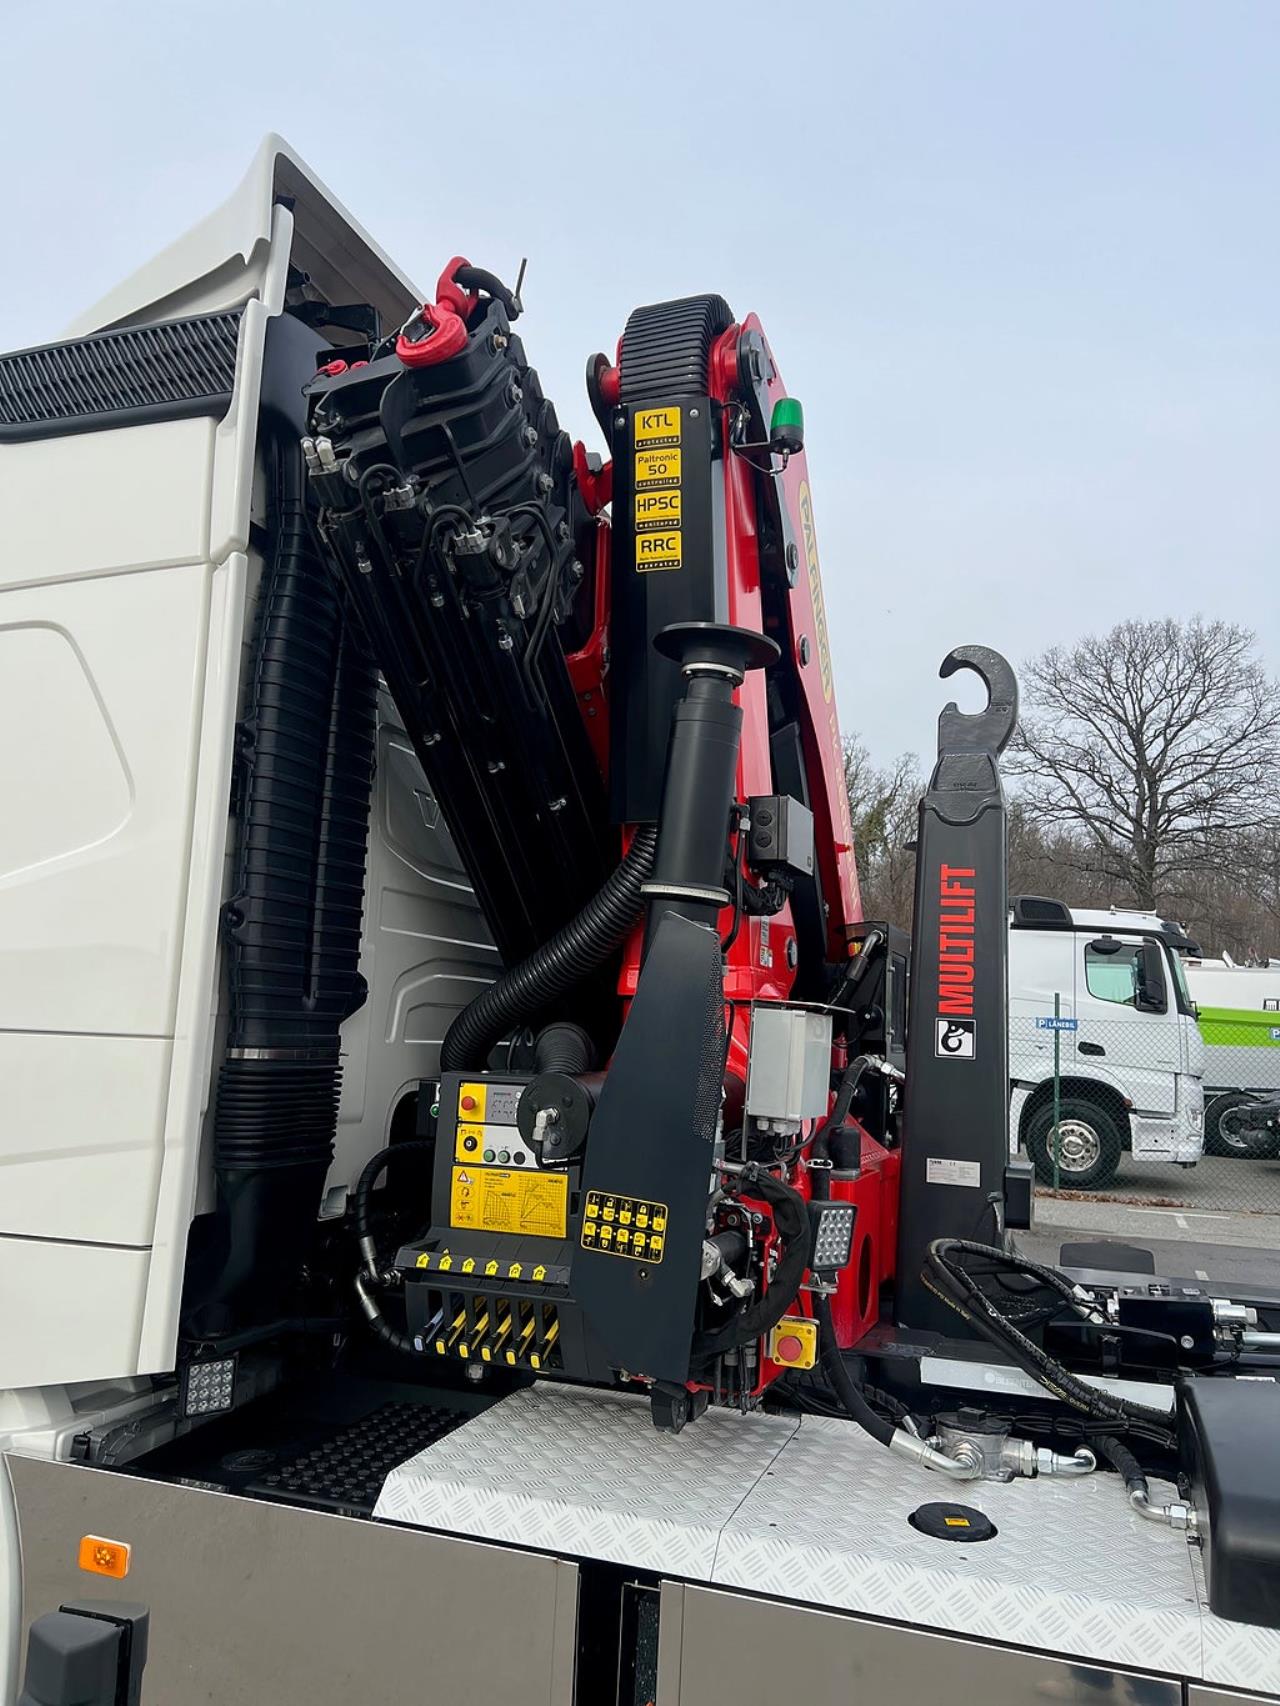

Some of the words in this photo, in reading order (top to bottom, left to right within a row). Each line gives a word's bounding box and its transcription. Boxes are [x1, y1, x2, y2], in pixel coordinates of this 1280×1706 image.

[642, 413, 673, 429] KTL
[638, 437, 677, 447] protected
[638, 453, 678, 464] Paltronic
[648, 464, 667, 476] 50
[638, 478, 678, 488] controlled
[637, 496, 679, 512] HPSC
[638, 520, 678, 529] monitored
[641, 537, 676, 554] RRC
[639, 561, 678, 570] operated
[801, 498, 832, 694] PALFINGER
[938, 864, 976, 1014] MULTILIFT
[1039, 1020, 1046, 1028] P
